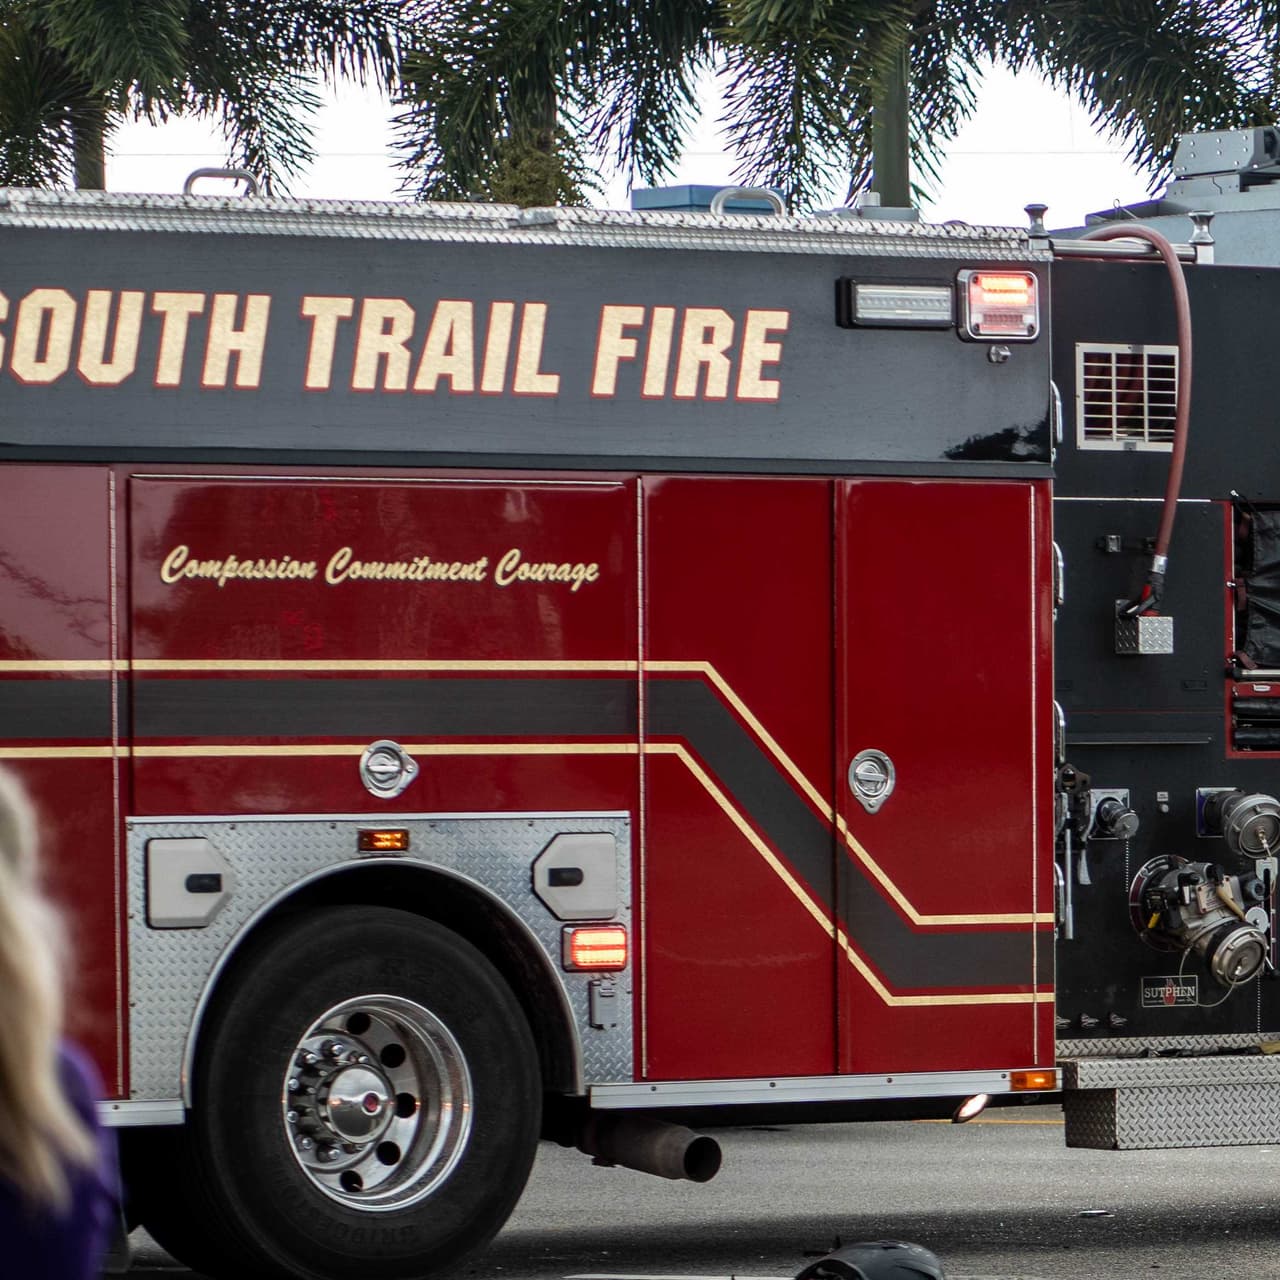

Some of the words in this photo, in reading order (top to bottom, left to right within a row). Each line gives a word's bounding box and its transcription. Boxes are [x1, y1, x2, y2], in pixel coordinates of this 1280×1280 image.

[0, 285, 272, 390] OUTH
[301, 294, 561, 396] TRAIL
[590, 304, 791, 402] FIRE
[159, 544, 318, 588] Compassion
[325, 546, 489, 587] Commitment
[494, 548, 600, 592] Courage
[1144, 986, 1196, 999] SUTPHEN
